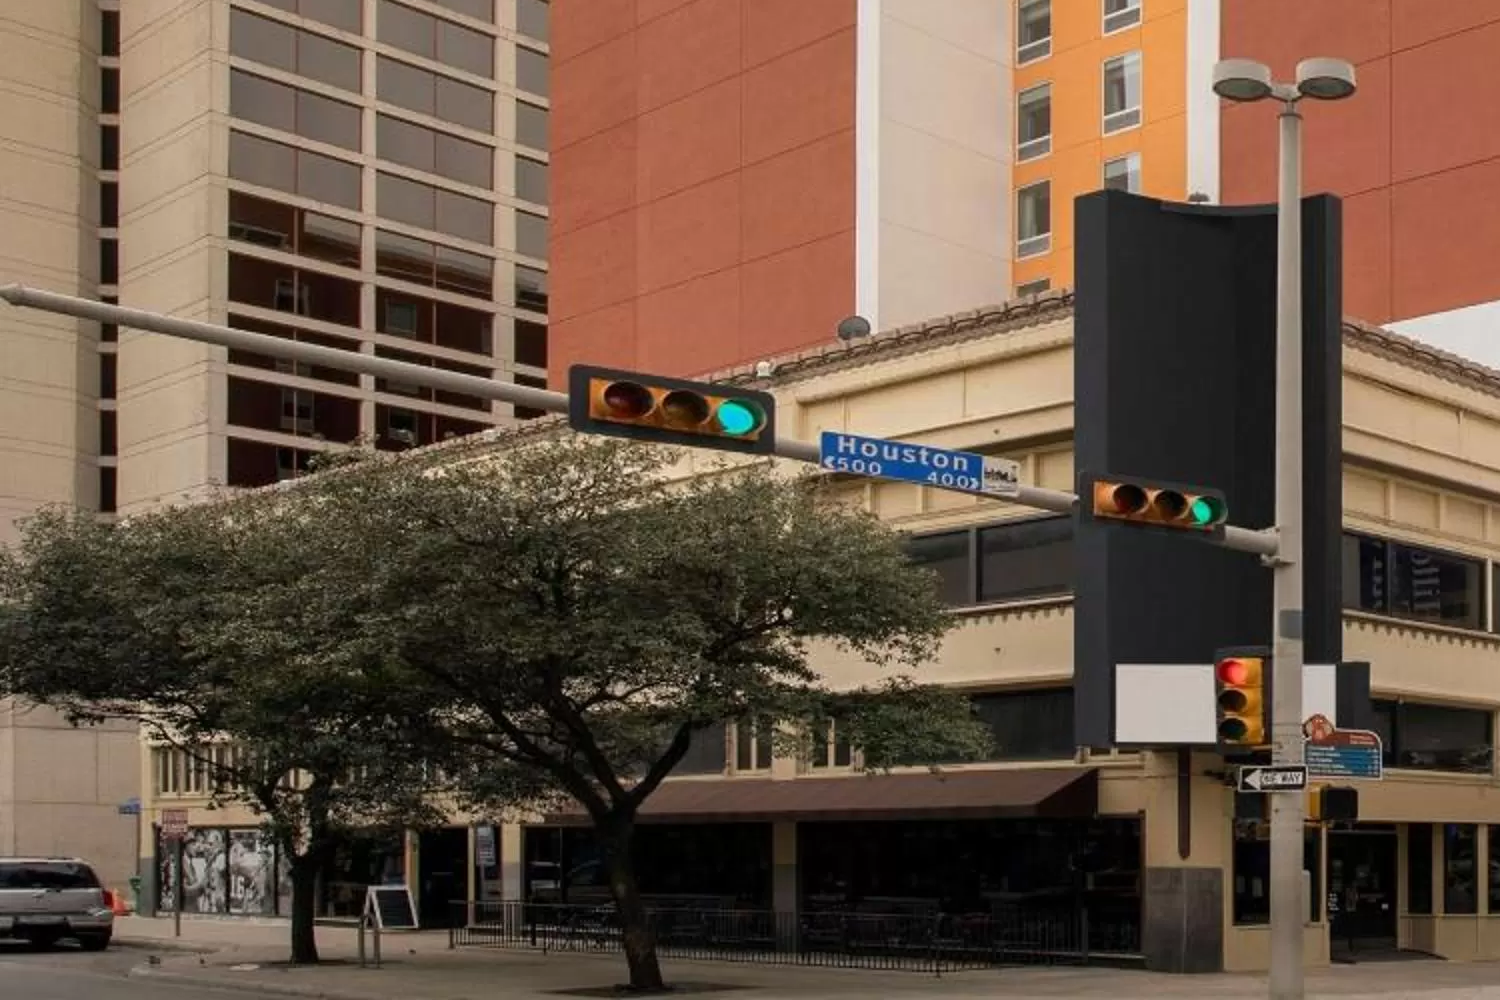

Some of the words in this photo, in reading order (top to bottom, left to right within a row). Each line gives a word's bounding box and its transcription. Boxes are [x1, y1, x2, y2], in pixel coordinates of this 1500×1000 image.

[837, 436, 968, 471] Houston
[837, 457, 882, 476] 500
[927, 471, 969, 490] 400
